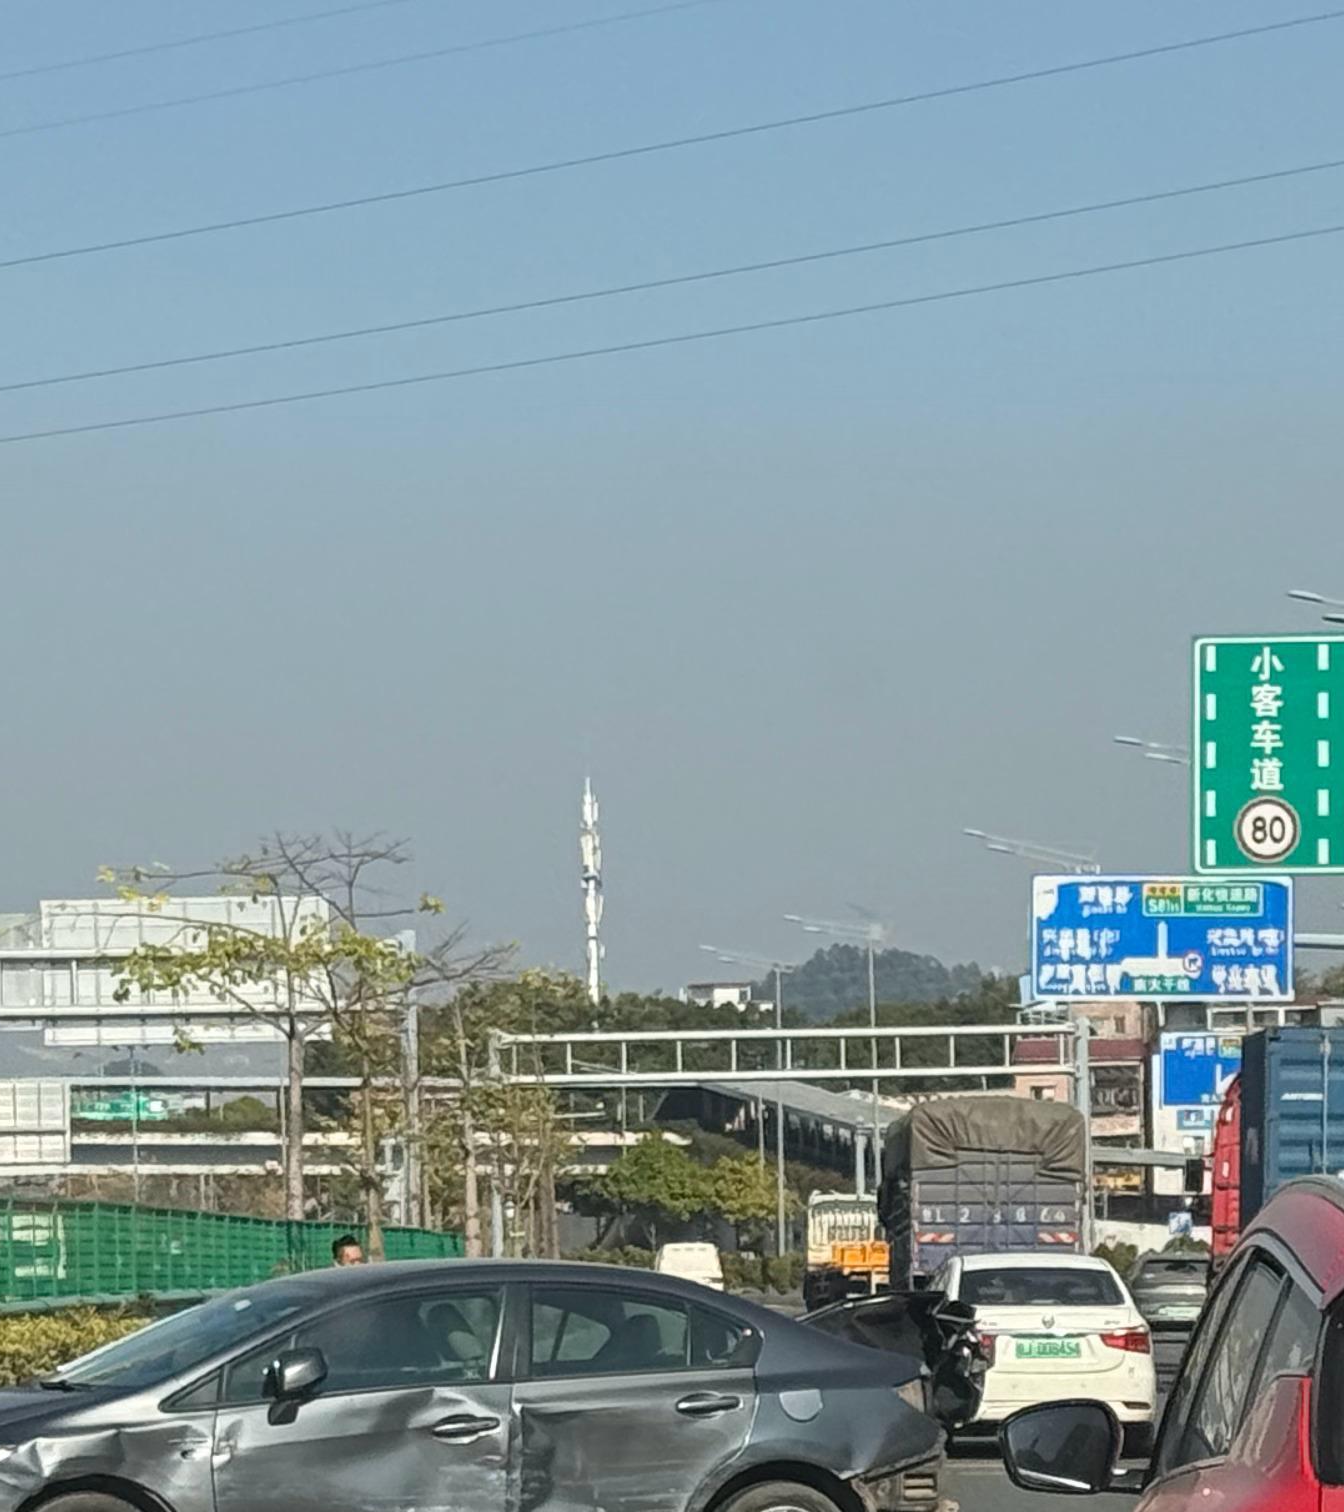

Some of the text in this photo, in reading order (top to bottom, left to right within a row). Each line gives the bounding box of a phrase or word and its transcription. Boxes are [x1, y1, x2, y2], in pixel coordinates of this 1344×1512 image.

[1250, 646, 1284, 790] 小客车道
[1252, 816, 1286, 843] 80
